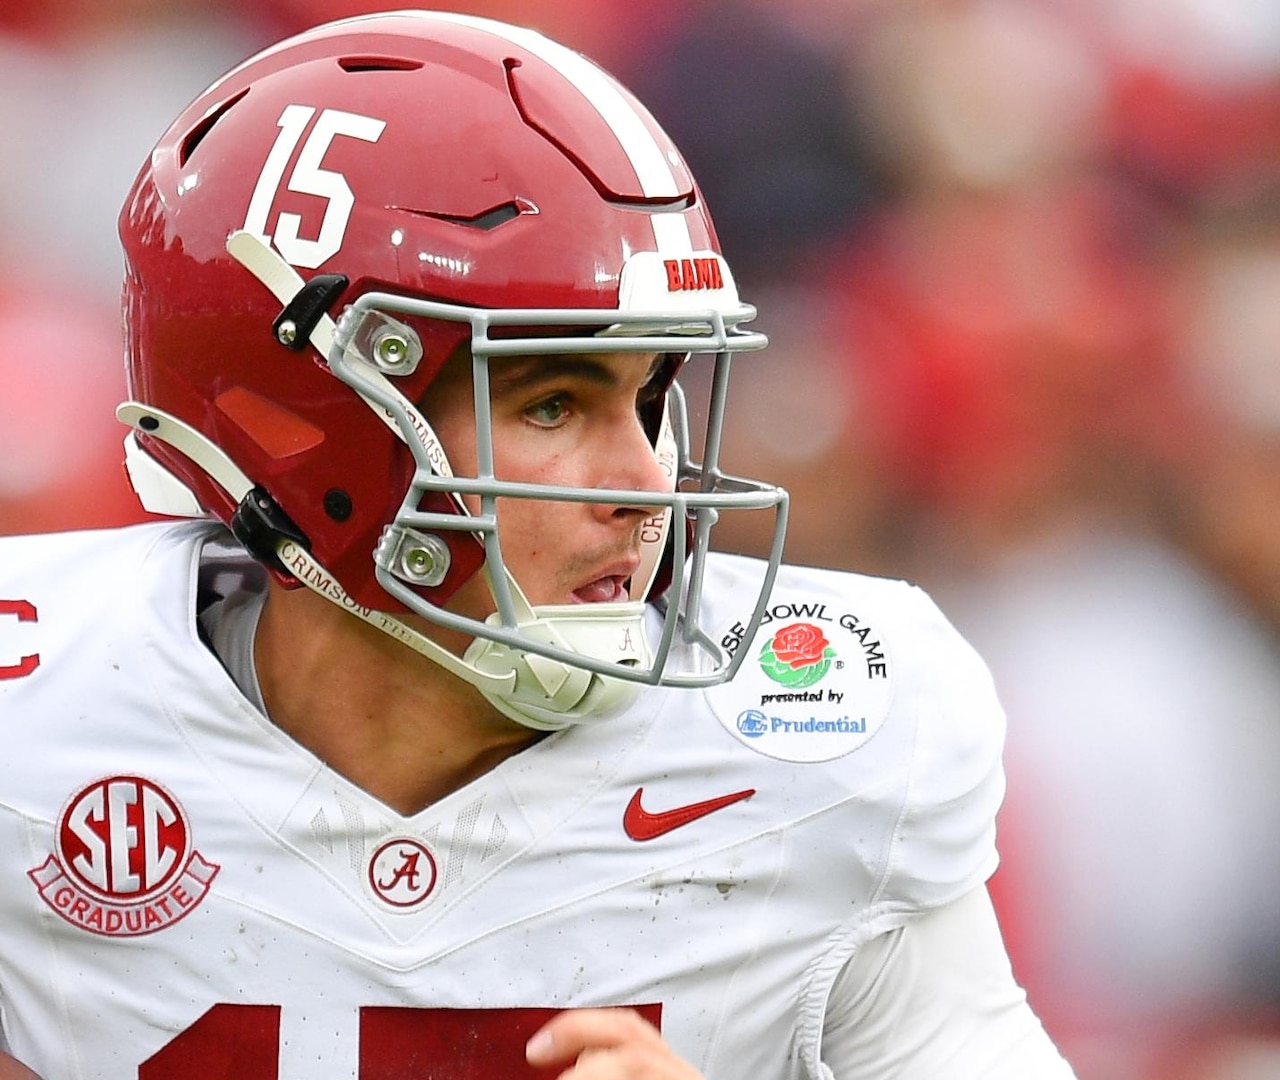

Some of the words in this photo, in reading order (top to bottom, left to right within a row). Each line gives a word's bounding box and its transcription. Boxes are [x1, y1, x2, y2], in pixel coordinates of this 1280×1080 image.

[242, 103, 388, 270] 15
[281, 541, 371, 619] CRIMSON
[839, 613, 887, 680] GAME
[760, 689, 823, 706] presented
[828, 688, 844, 705] by
[770, 715, 867, 733] Prudential
[67, 781, 178, 894] SEC
[377, 849, 421, 892] A
[53, 884, 194, 932] GRADUATE
